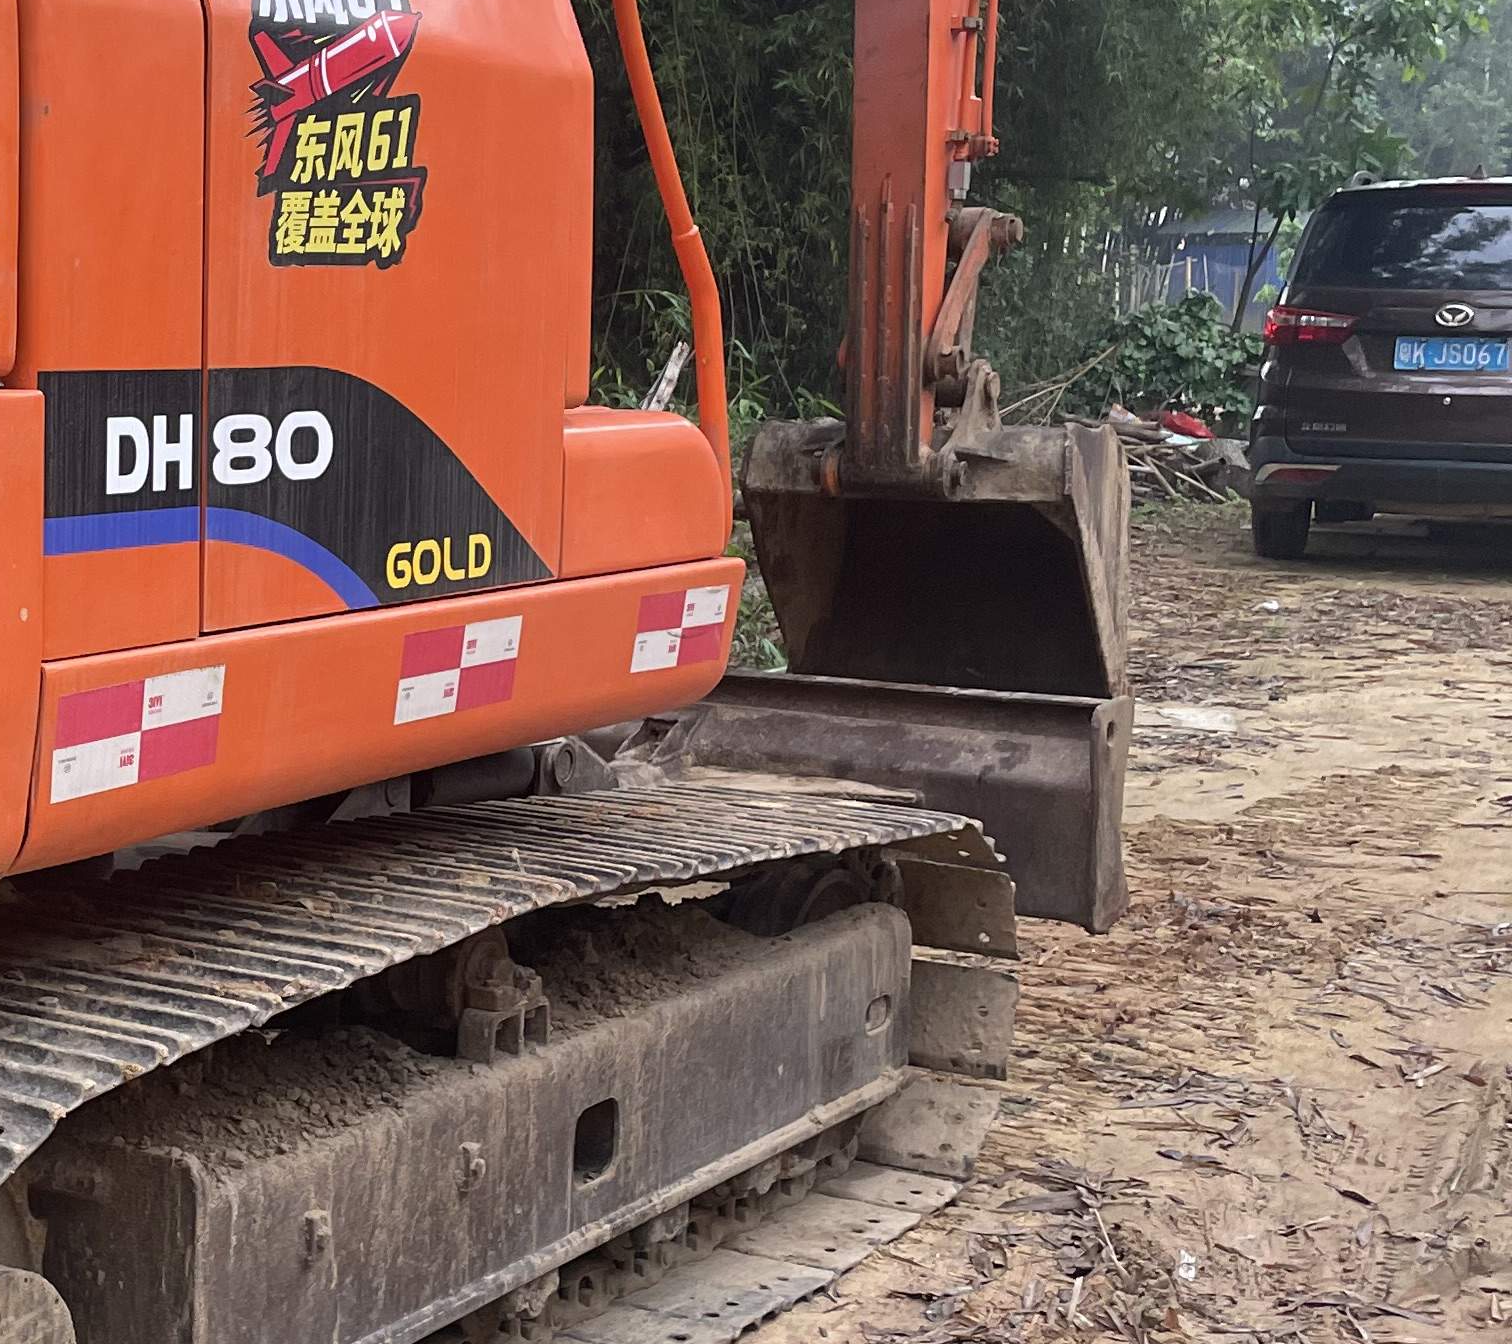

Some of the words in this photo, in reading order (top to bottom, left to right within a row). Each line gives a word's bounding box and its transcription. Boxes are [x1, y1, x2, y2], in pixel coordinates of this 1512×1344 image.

[289, 106, 413, 184] 东风61
[275, 186, 406, 260] 覆盖全球
[105, 413, 194, 495] DH
[212, 410, 334, 484] 80
[386, 533, 492, 589] GOLD
